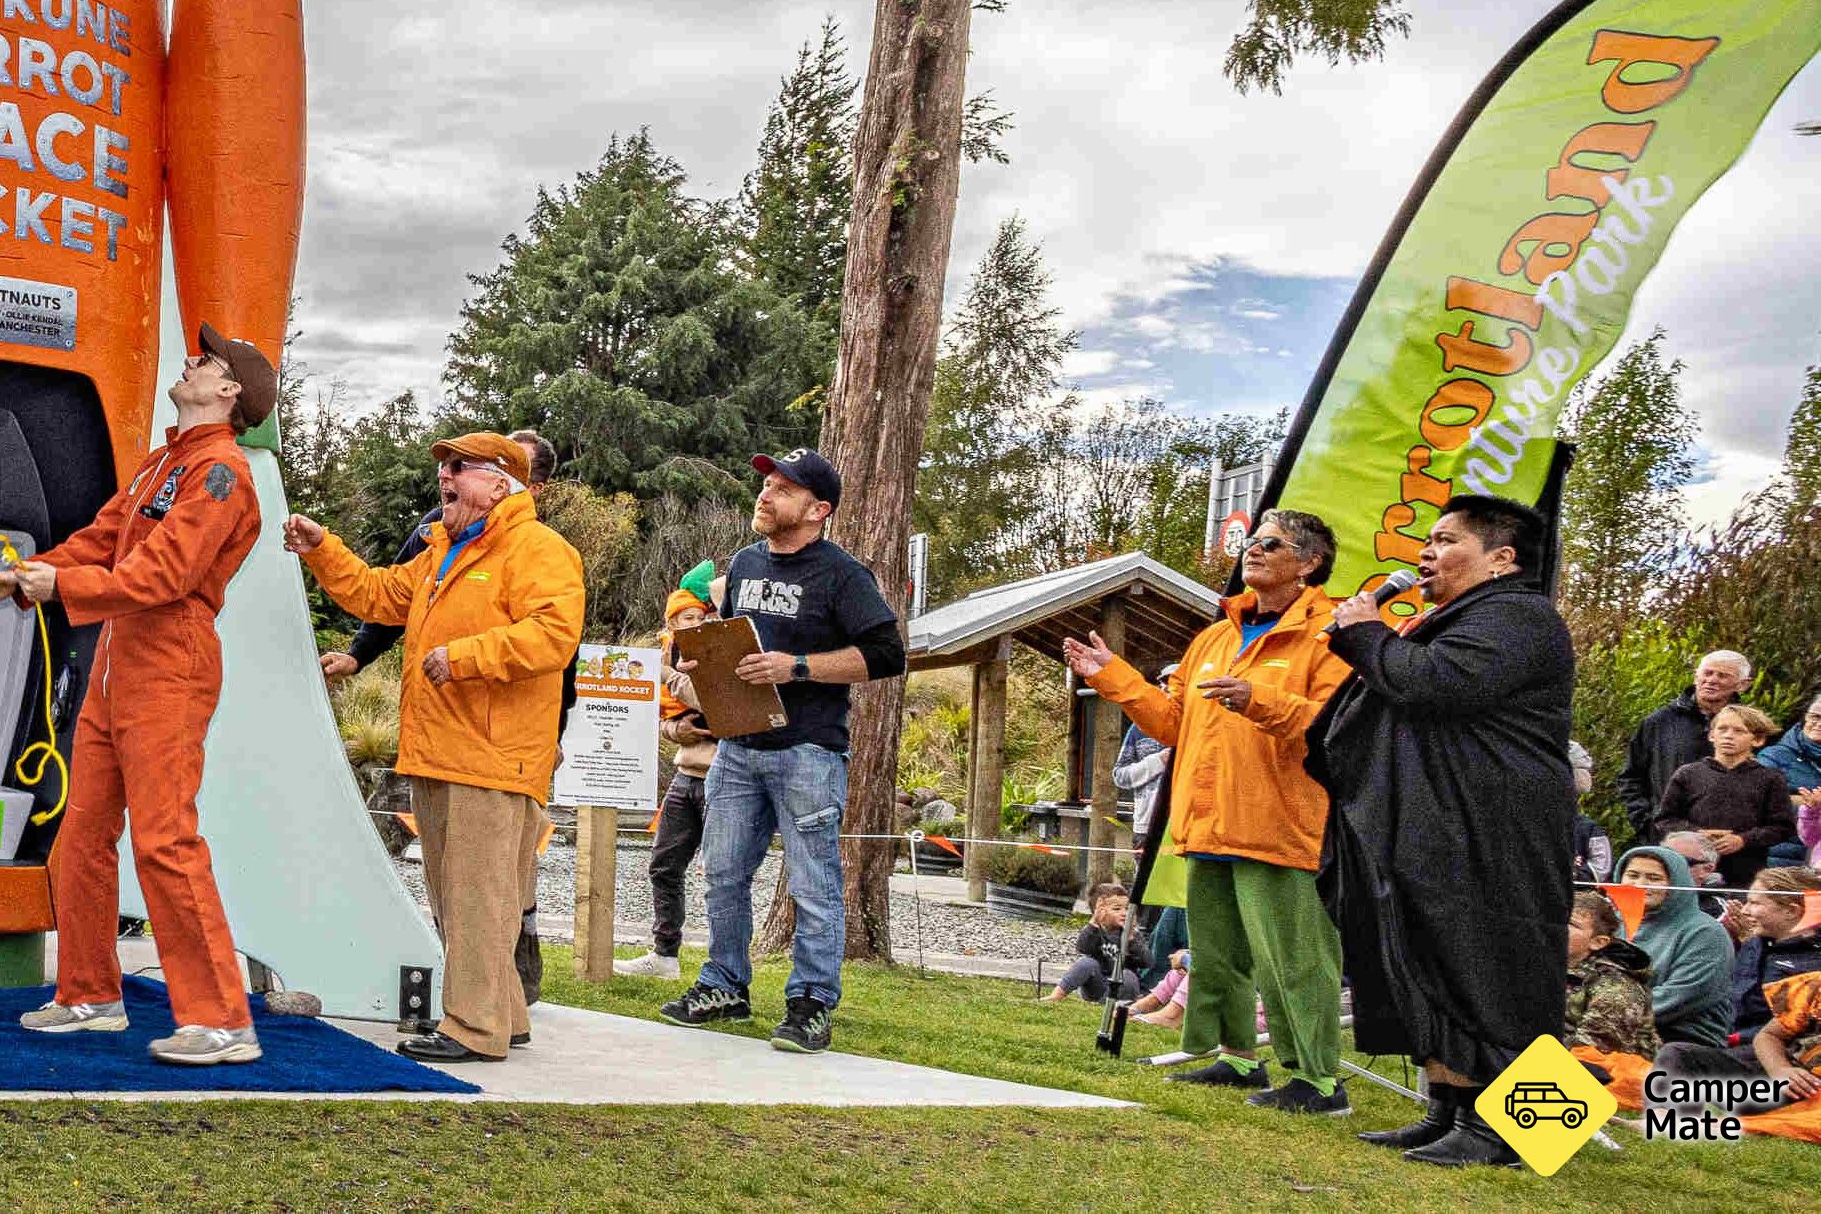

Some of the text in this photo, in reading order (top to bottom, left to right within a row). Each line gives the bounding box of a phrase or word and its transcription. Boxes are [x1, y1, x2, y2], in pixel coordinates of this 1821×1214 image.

[1534, 174, 1675, 335] Park
[783, 448, 807, 462] S
[585, 704, 629, 714] SPONSORS
